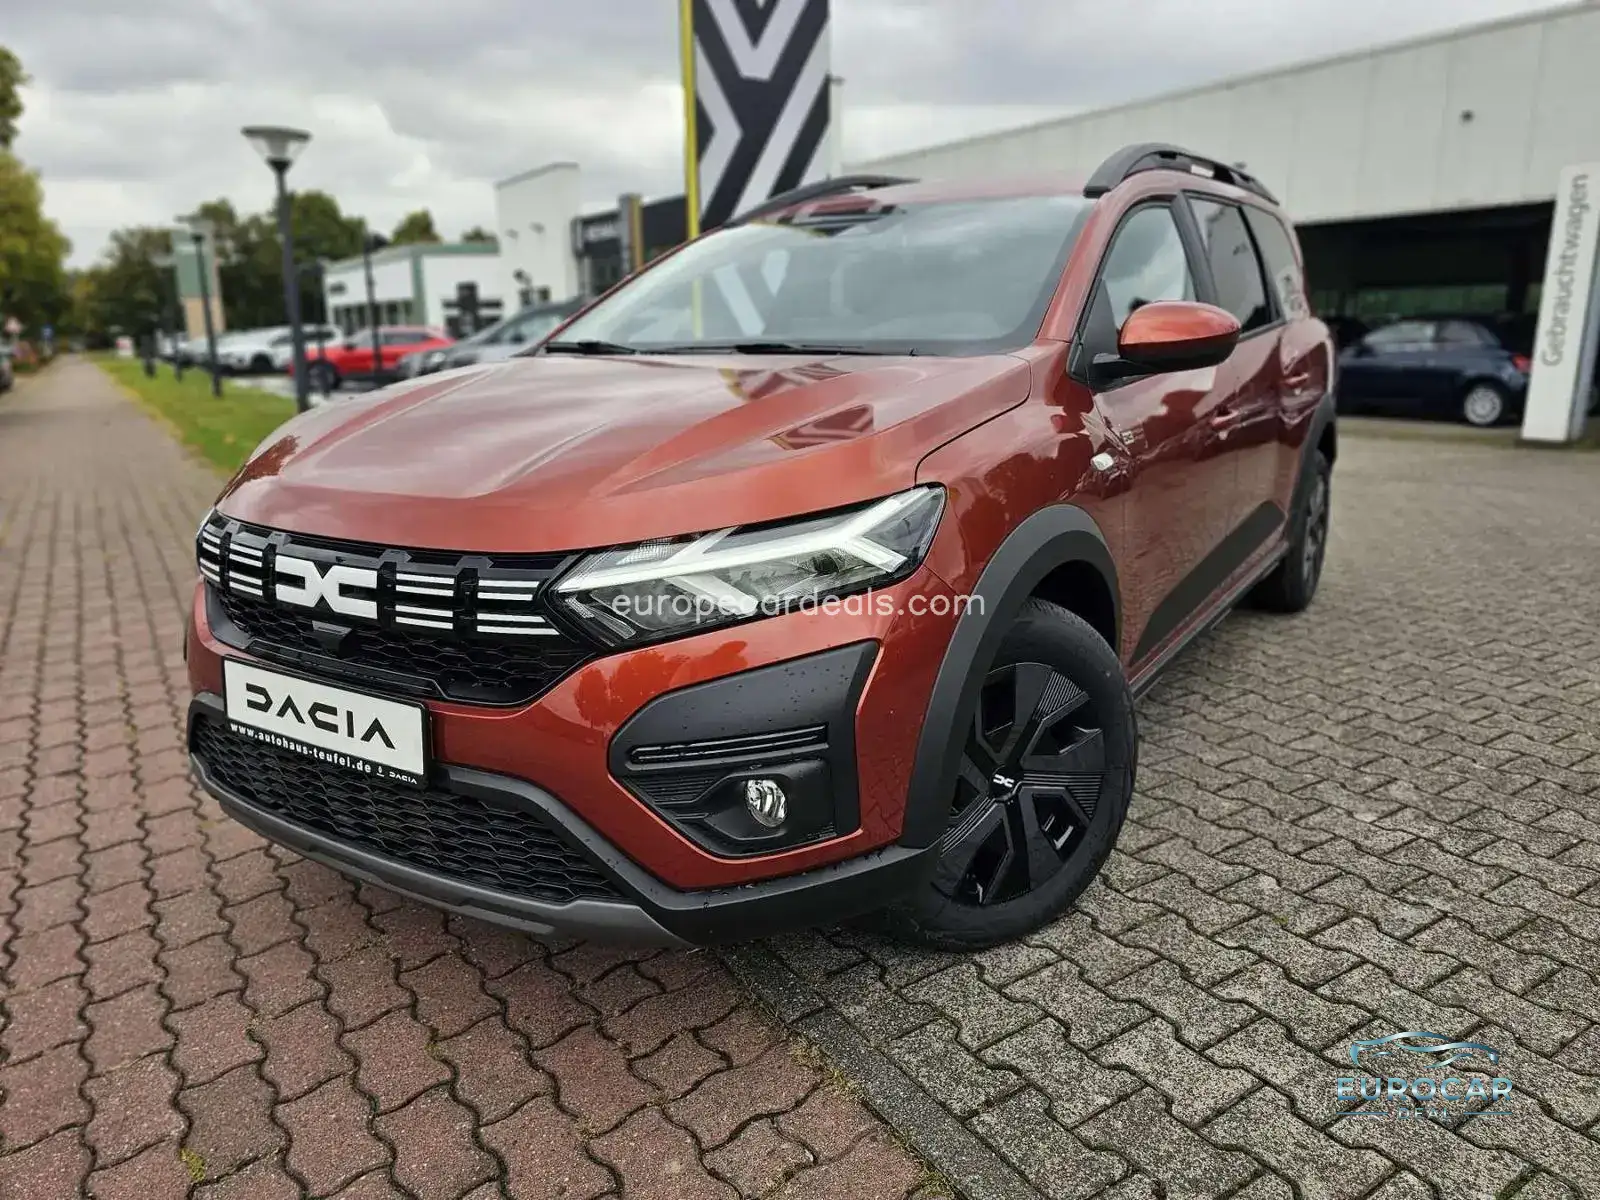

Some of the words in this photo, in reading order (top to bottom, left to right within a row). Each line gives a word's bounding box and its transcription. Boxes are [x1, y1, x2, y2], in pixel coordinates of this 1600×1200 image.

[1541, 173, 1590, 367] Gebrauchtwagen
[246, 682, 396, 750] DACIA
[230, 723, 372, 774] www.autohaus-teufel.de
[389, 771, 418, 785] DACIA
